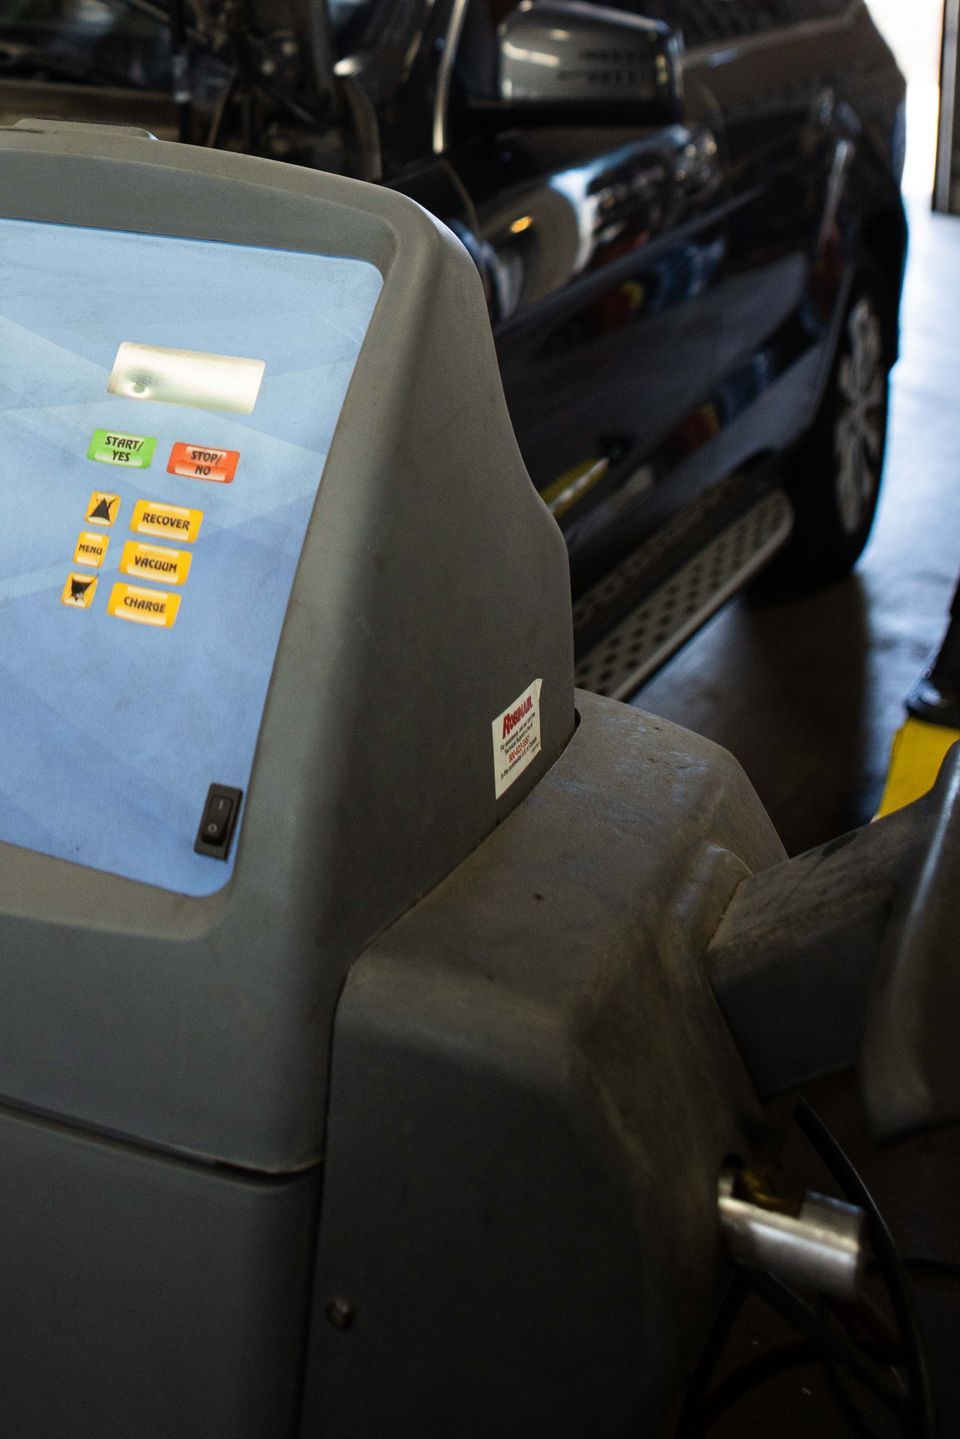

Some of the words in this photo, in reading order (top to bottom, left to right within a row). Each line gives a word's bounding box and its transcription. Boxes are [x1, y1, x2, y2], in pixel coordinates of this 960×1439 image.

[104, 434, 144, 452] START/
[111, 449, 131, 463] YES
[190, 449, 223, 465] STOP/
[194, 464, 211, 477] NO
[142, 512, 191, 531] RECOVER
[78, 543, 103, 556] MENU
[134, 555, 178, 574] VACUUM
[123, 595, 166, 614] CHARGE
